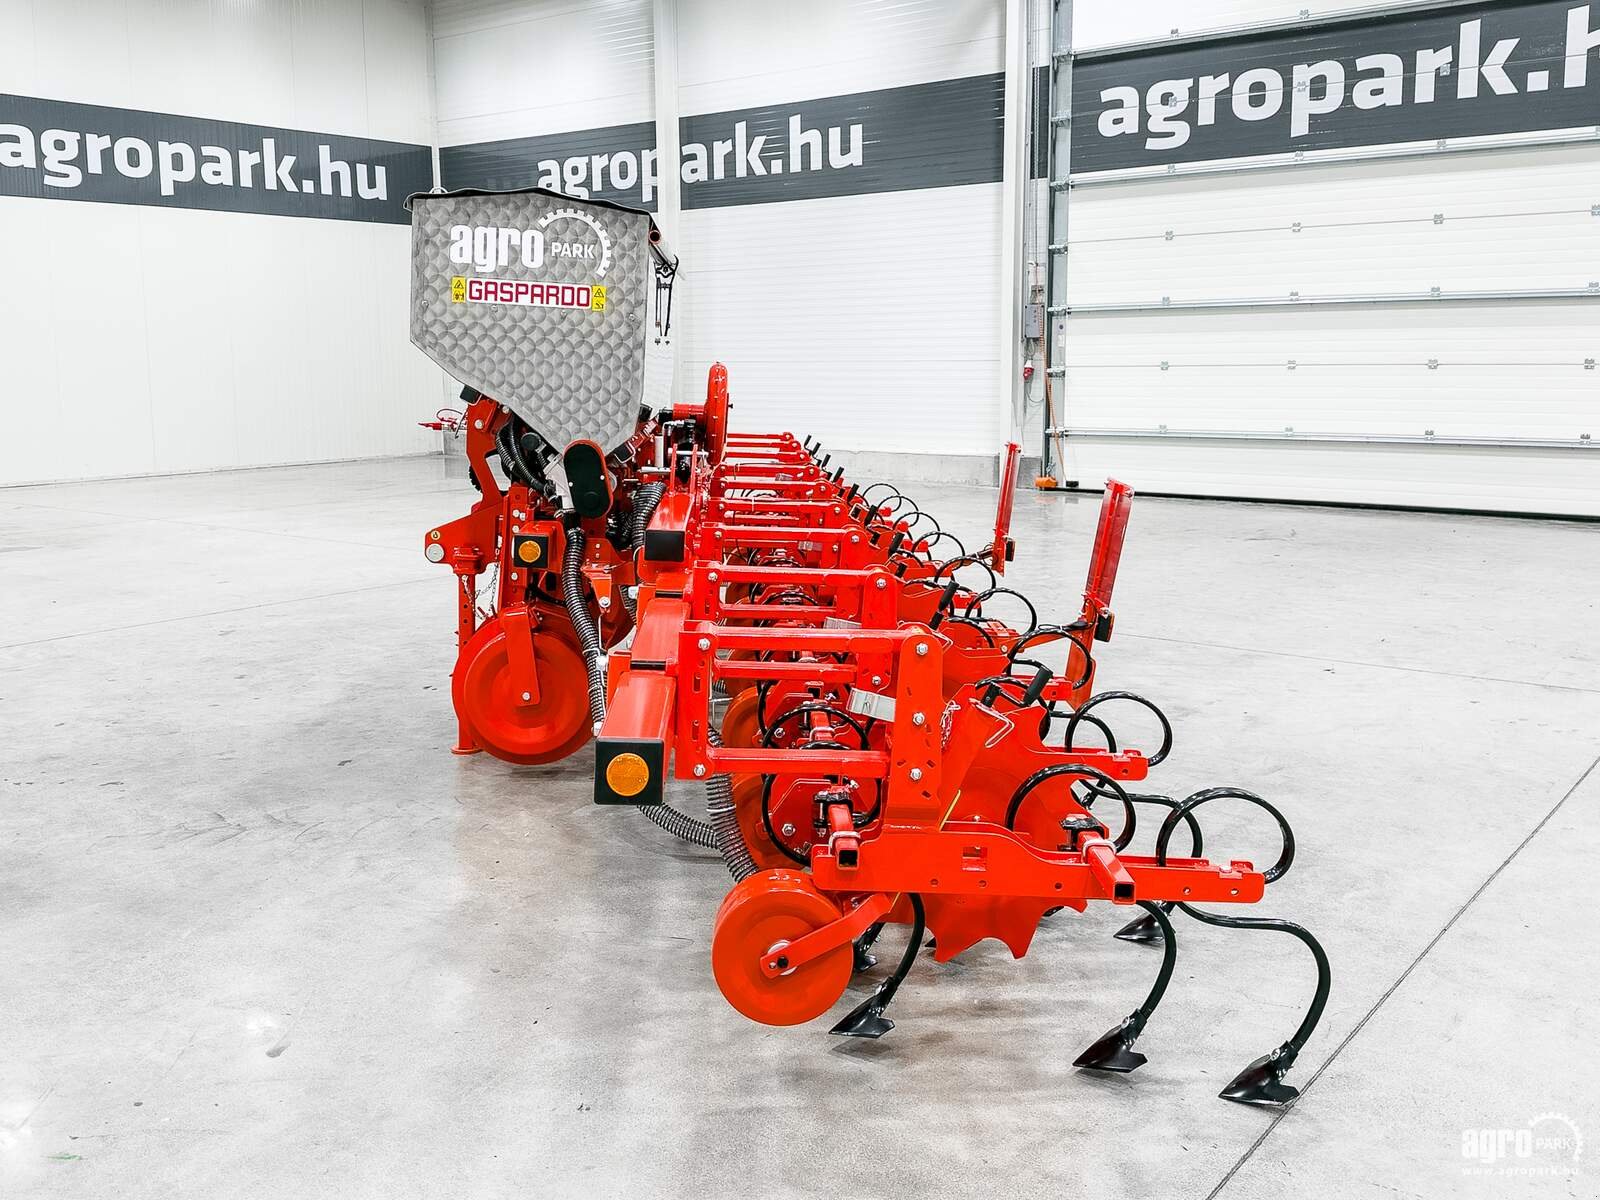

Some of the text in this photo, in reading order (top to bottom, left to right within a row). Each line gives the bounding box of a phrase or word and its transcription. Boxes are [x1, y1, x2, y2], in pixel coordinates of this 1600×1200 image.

[0, 123, 388, 201] agropark.hu
[449, 224, 595, 273] agro PARK
[468, 280, 591, 308] GASPARDO
